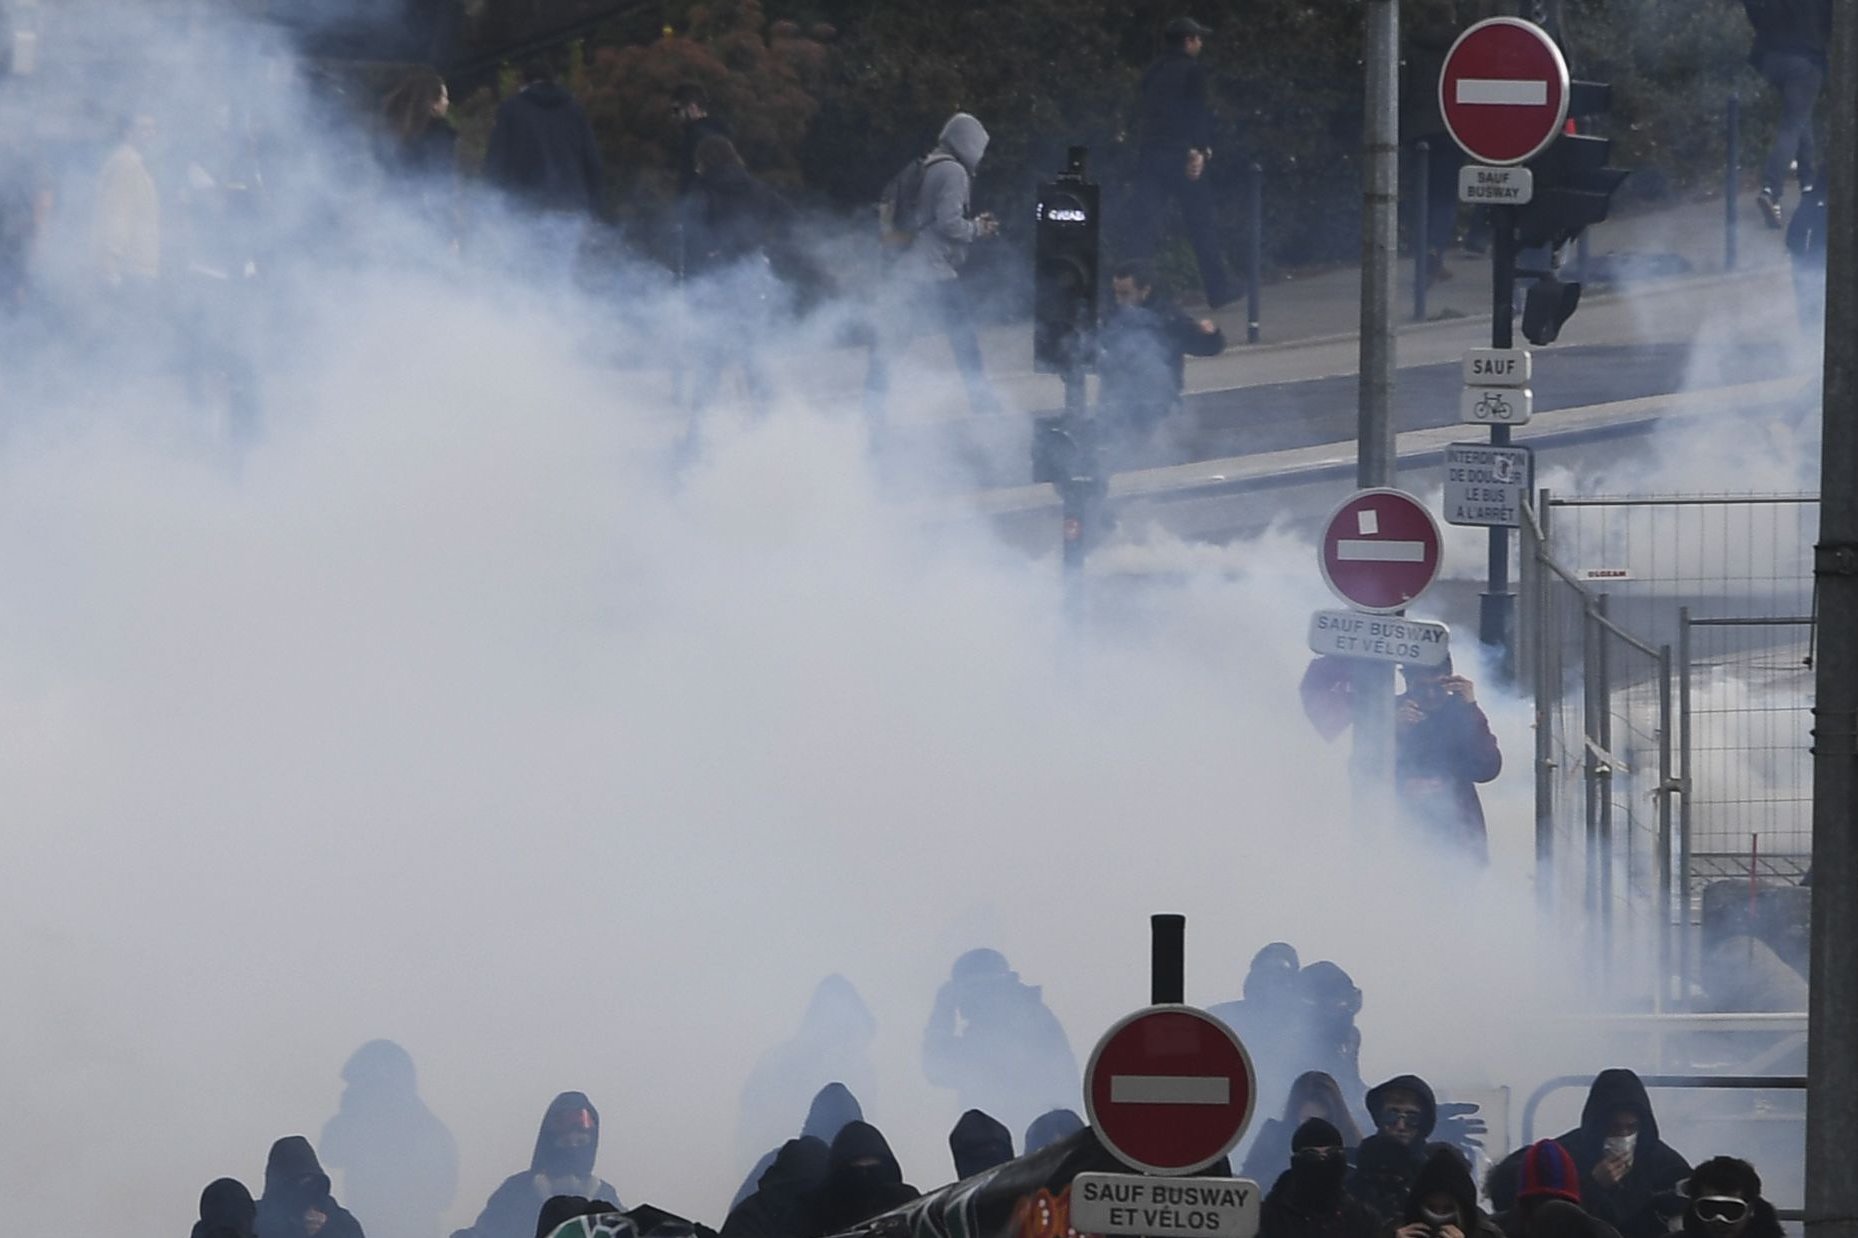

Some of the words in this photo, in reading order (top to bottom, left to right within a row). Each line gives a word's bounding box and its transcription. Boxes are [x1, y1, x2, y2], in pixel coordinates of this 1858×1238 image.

[1477, 171, 1509, 183] SAUF
[1467, 185, 1519, 198] BUSWAY
[1473, 359, 1515, 374] SAUF
[1450, 468, 1464, 482] DE
[1466, 487, 1479, 501] LE
[1483, 489, 1505, 502] BUS
[1317, 616, 1364, 633] SAUF
[1370, 622, 1444, 643] BUSWAY
[1336, 636, 1357, 650] ET
[1362, 638, 1420, 658] VÉLOS
[1083, 1182, 1144, 1203] SAUF
[1152, 1186, 1249, 1208] BUSWAY
[1110, 1208, 1138, 1226] ET
[1144, 1206, 1220, 1230] VÉLOS
